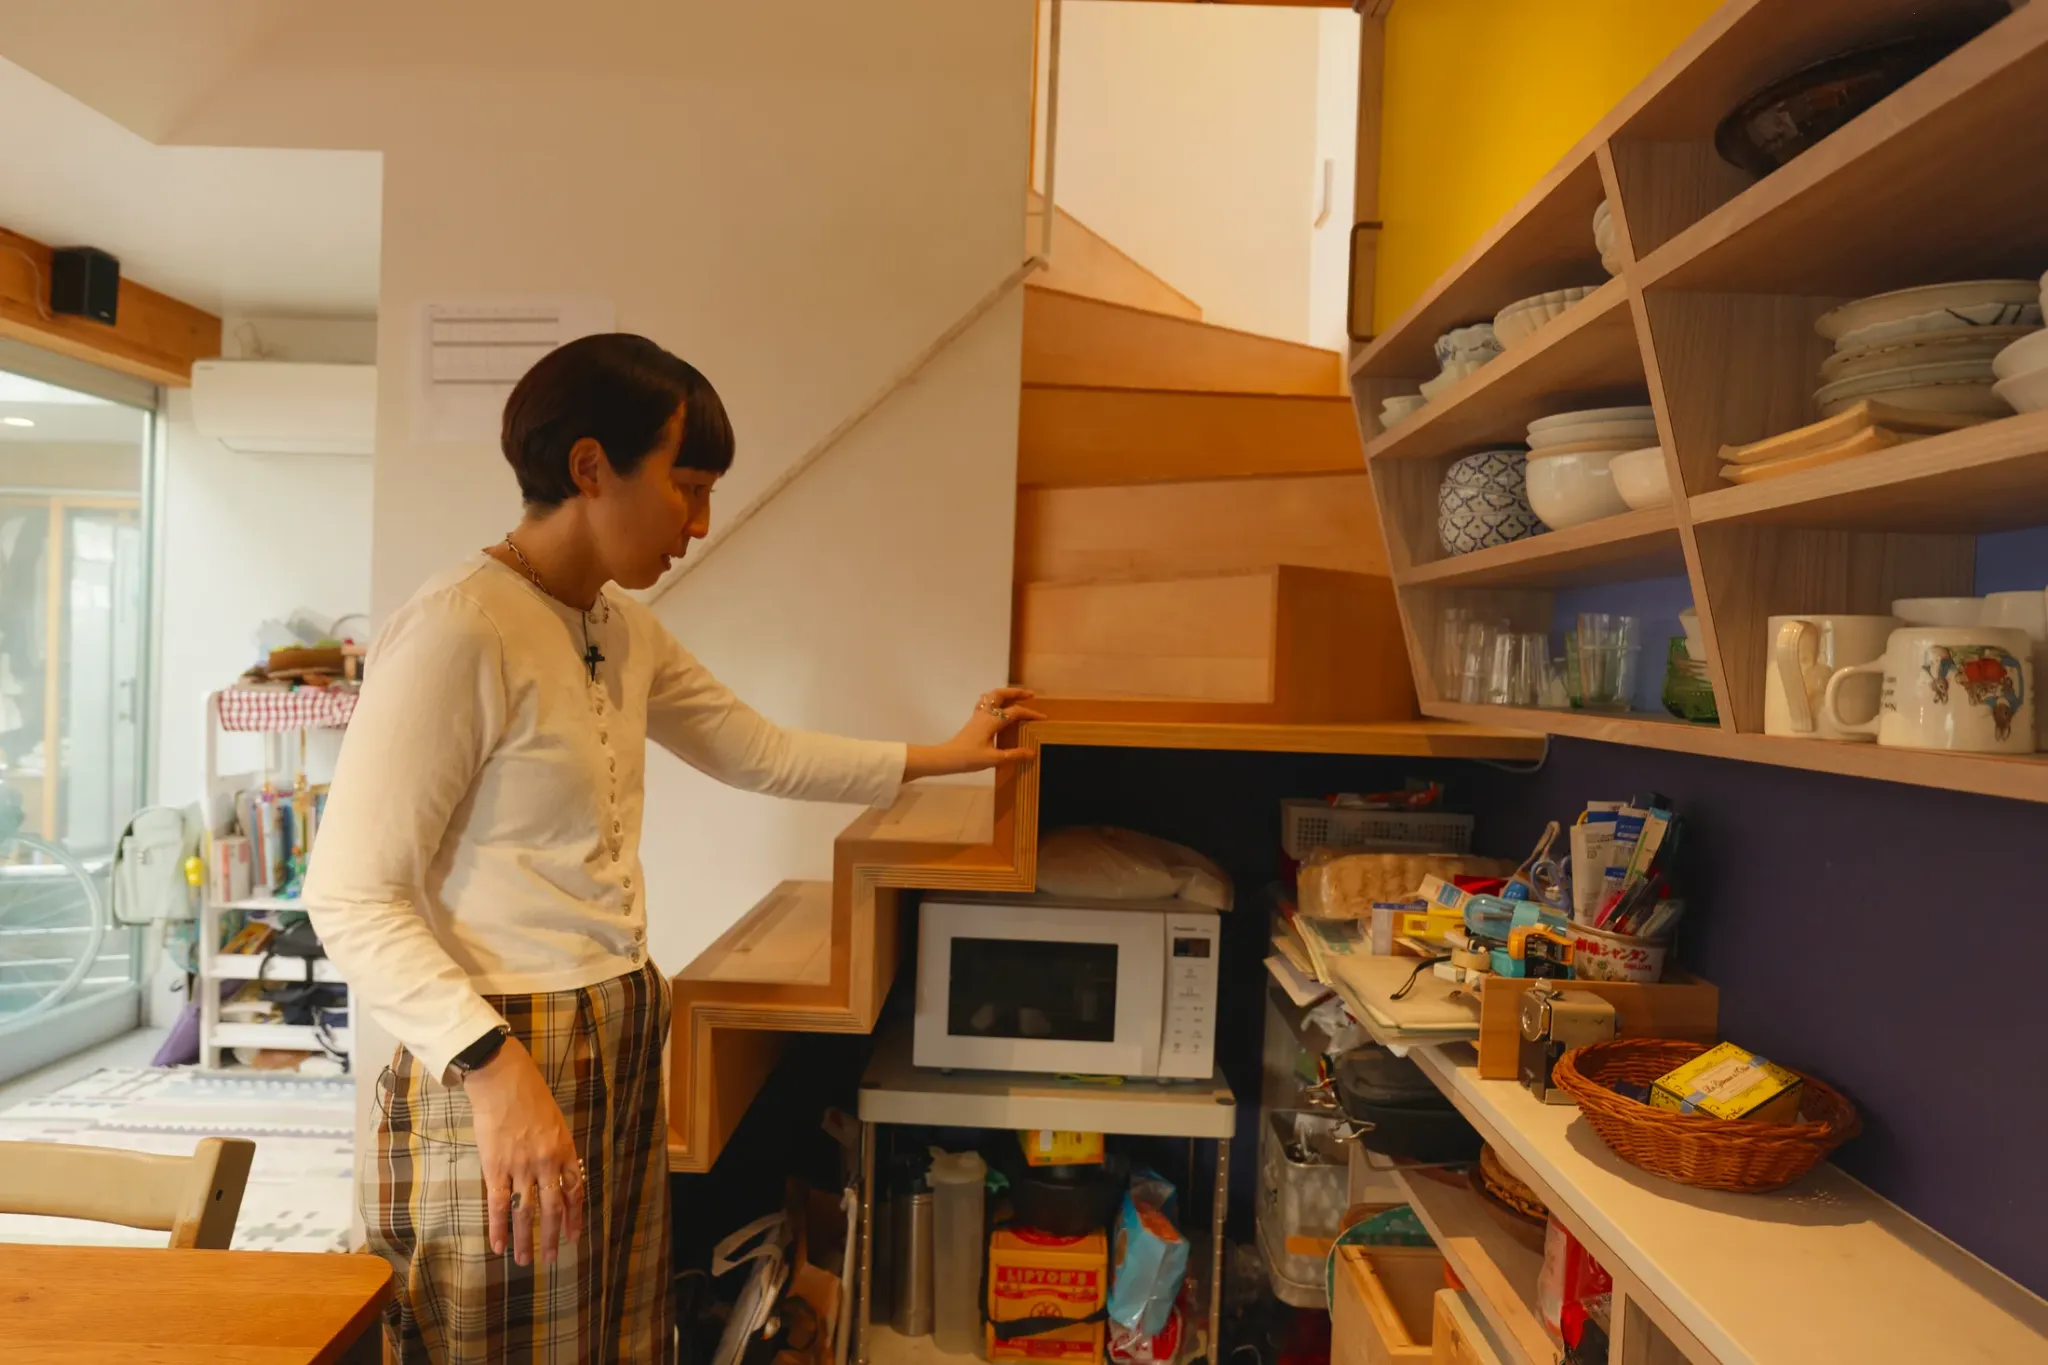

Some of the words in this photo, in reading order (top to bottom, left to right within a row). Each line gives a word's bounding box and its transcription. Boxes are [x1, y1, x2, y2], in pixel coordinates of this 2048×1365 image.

[1575, 937, 1649, 961] 創味シャンタン
